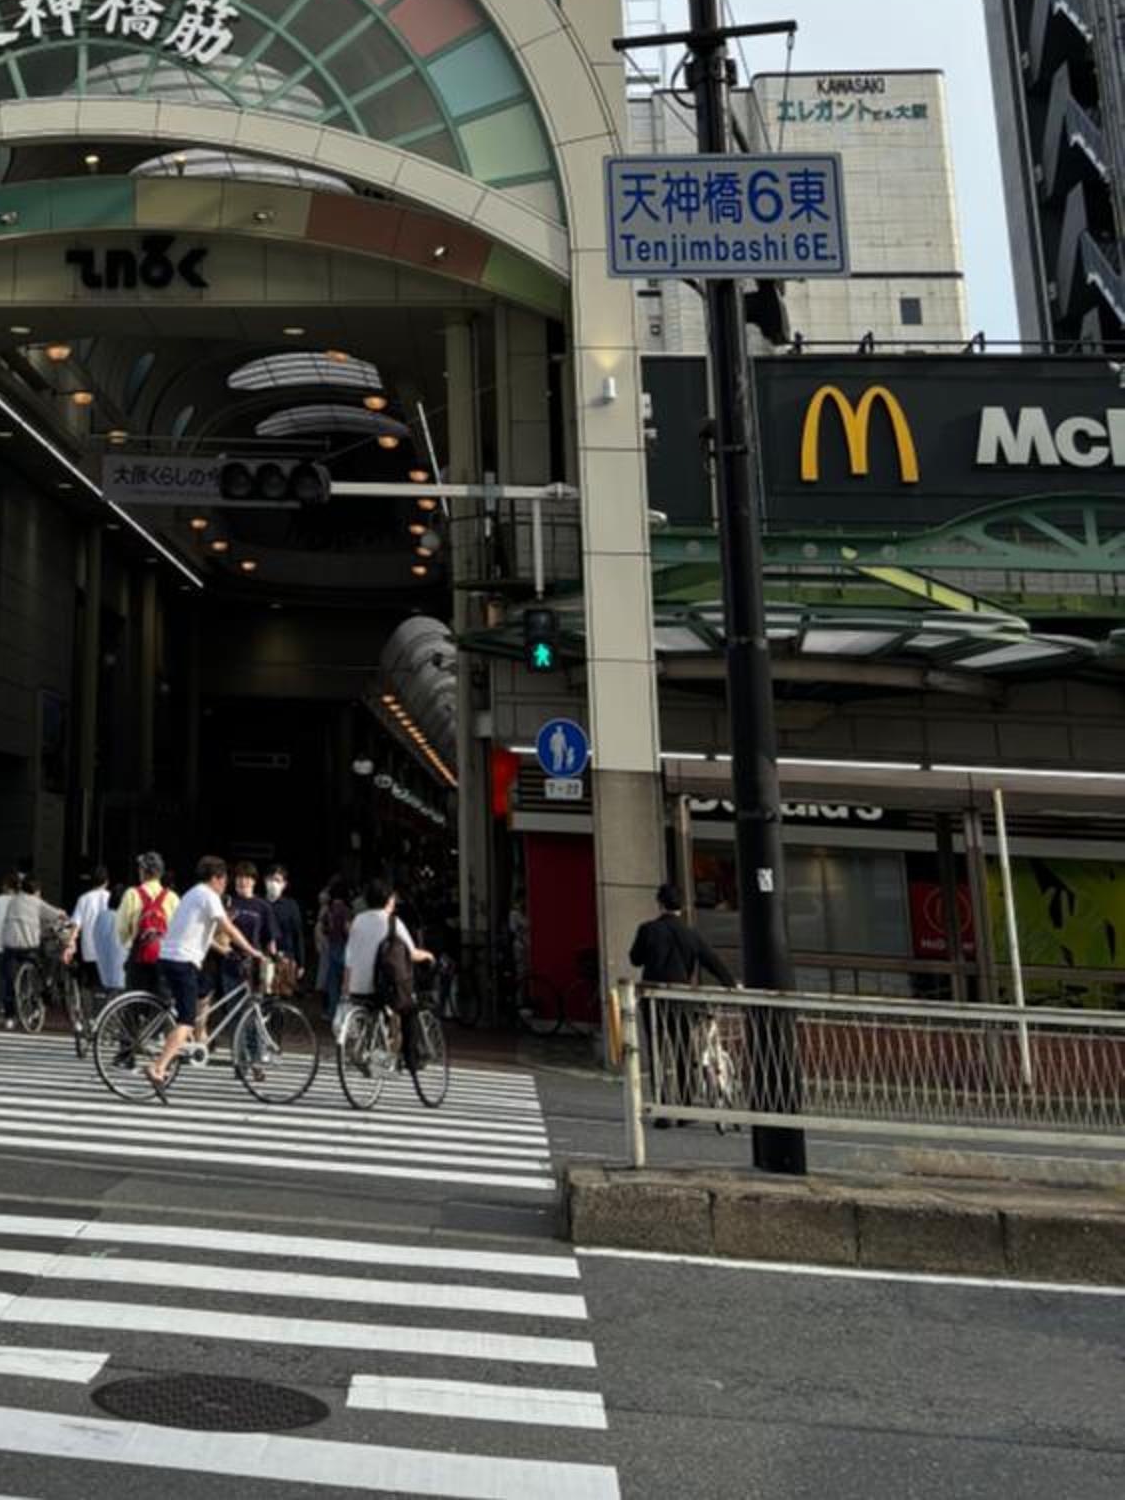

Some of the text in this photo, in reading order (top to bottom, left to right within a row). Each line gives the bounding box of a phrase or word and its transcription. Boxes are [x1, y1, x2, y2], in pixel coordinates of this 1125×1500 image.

[816, 77, 886, 94] KAWASAKI
[620, 168, 830, 224] 天神橋6東
[620, 233, 787, 267] Tenjimbashi
